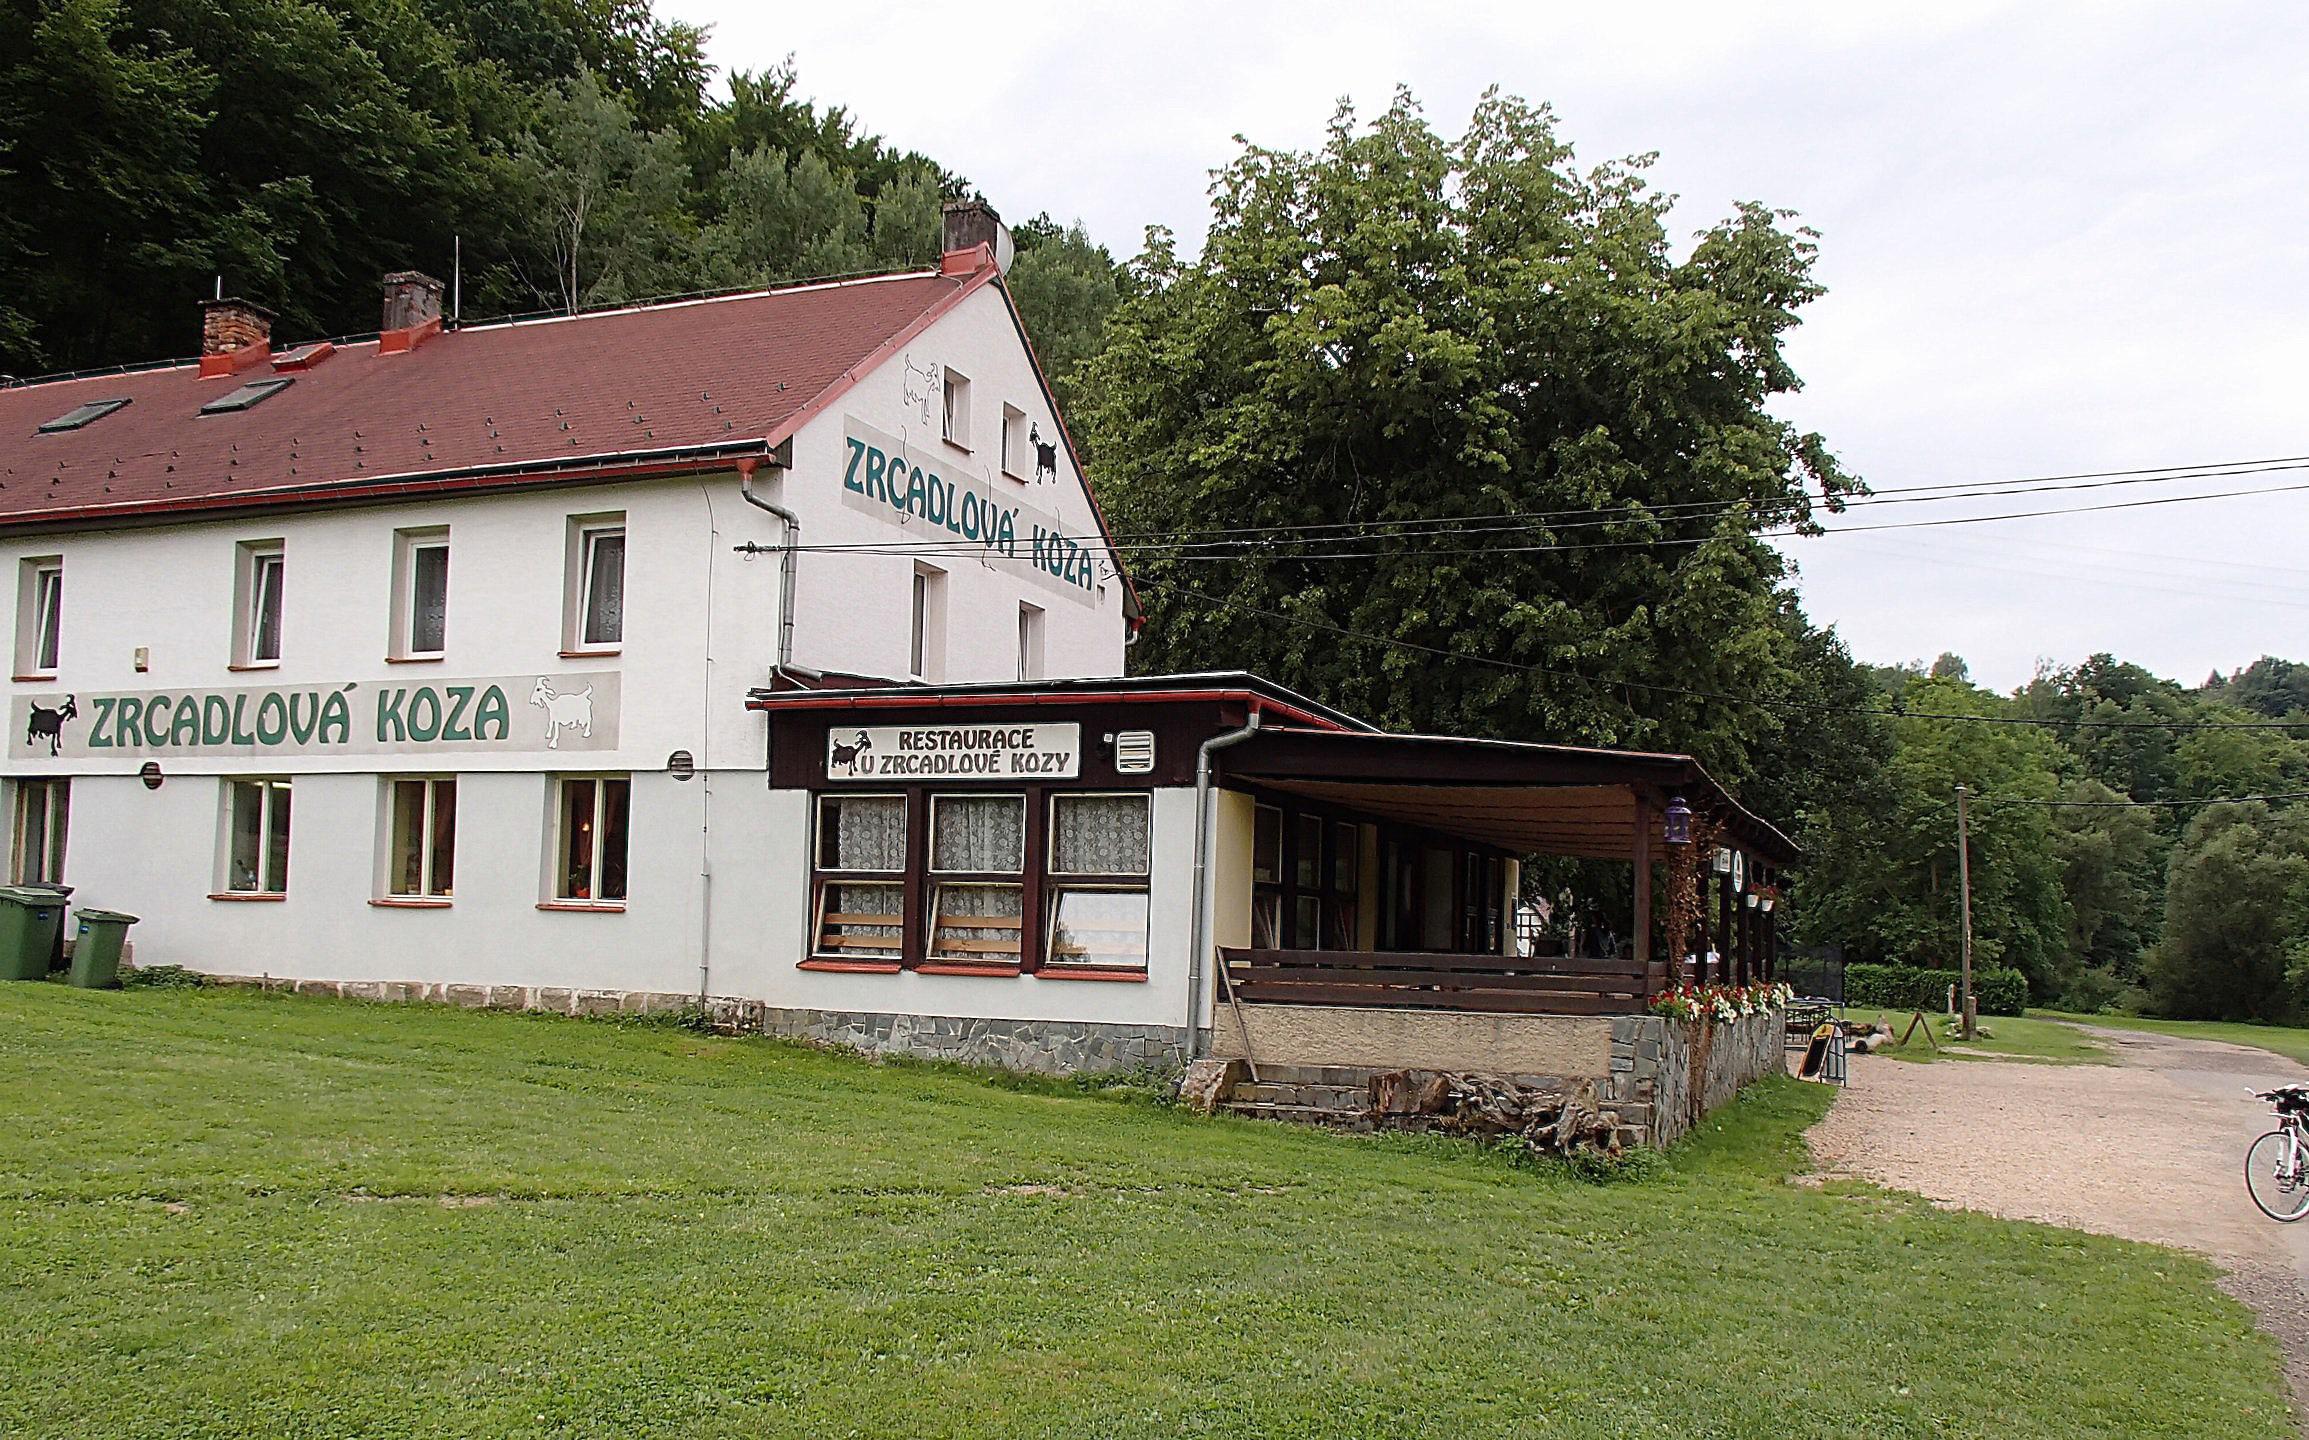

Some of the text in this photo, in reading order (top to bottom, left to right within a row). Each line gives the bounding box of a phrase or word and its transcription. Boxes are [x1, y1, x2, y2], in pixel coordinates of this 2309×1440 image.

[843, 436, 1093, 591] ZRCADLOVÁ KOZA
[88, 682, 511, 748] ZRCADLOVÁ KOZA
[860, 750, 1070, 775] U ZRCADLOVÉ KOZY
[899, 729, 1035, 751] RESTAURACE
